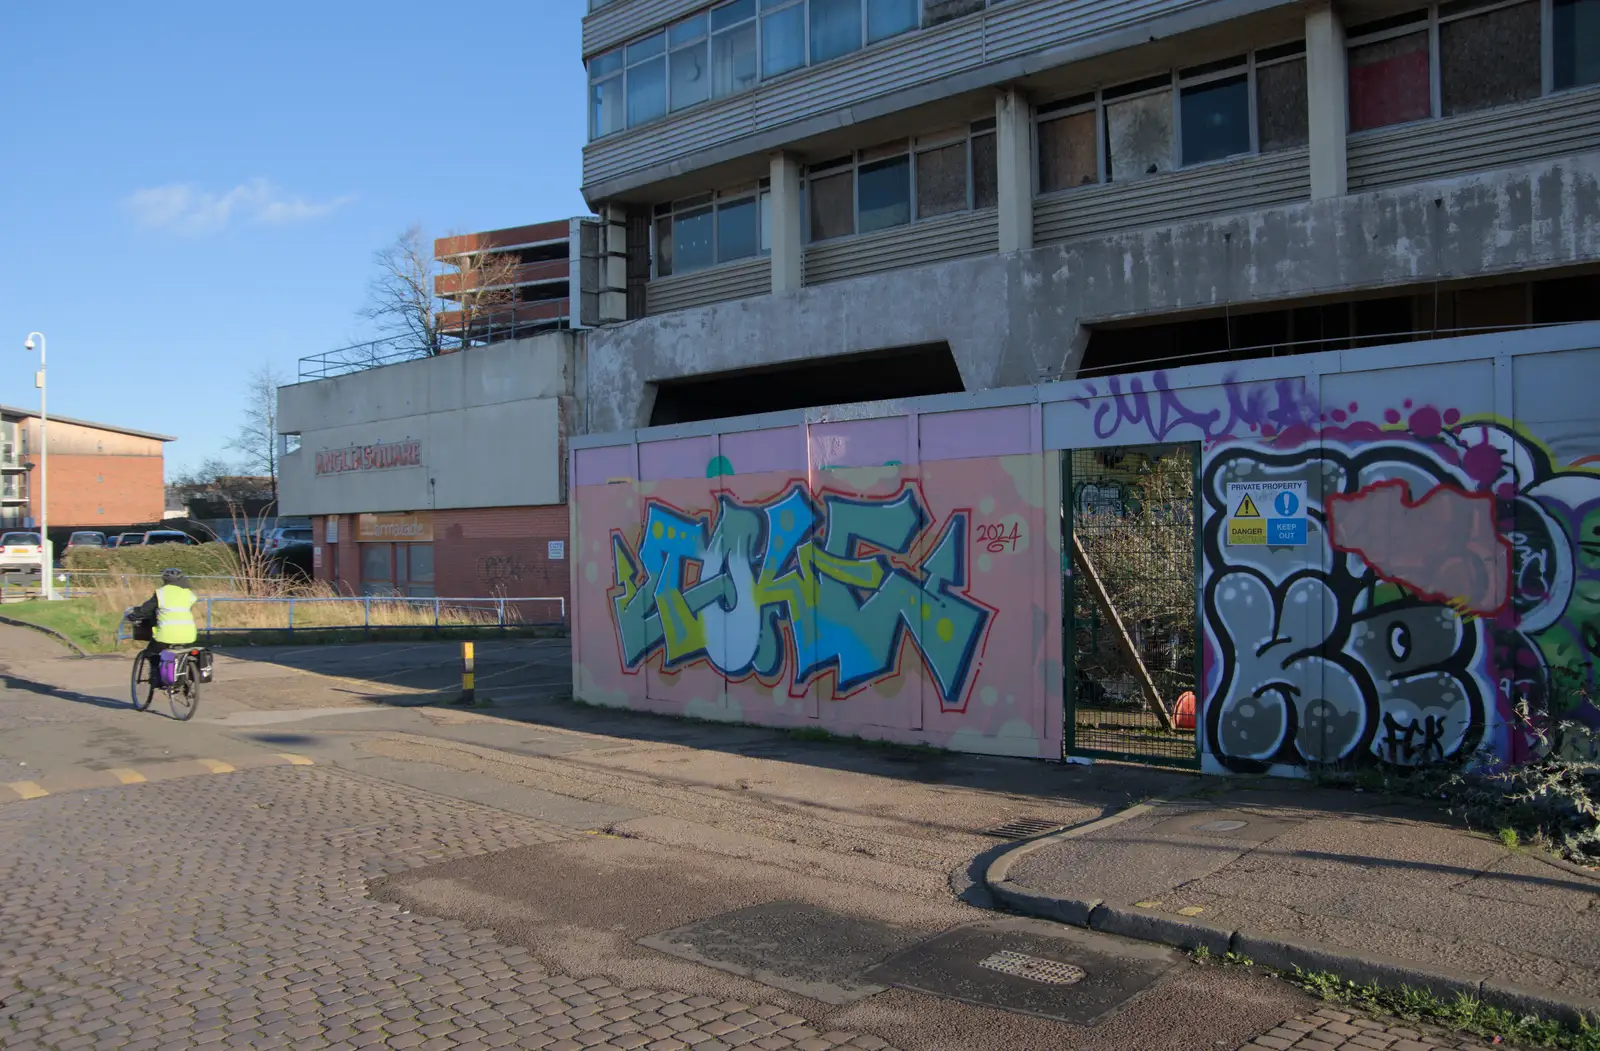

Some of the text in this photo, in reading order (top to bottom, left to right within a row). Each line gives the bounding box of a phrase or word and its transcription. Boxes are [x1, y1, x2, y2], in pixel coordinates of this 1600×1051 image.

[316, 441, 421, 475] ANGLIA SQUARE
[1231, 482, 1303, 491] PRIVATE PROPERTY
[361, 516, 425, 537] armalade
[976, 522, 1022, 551] 2024
[1276, 523, 1297, 531] KEEP
